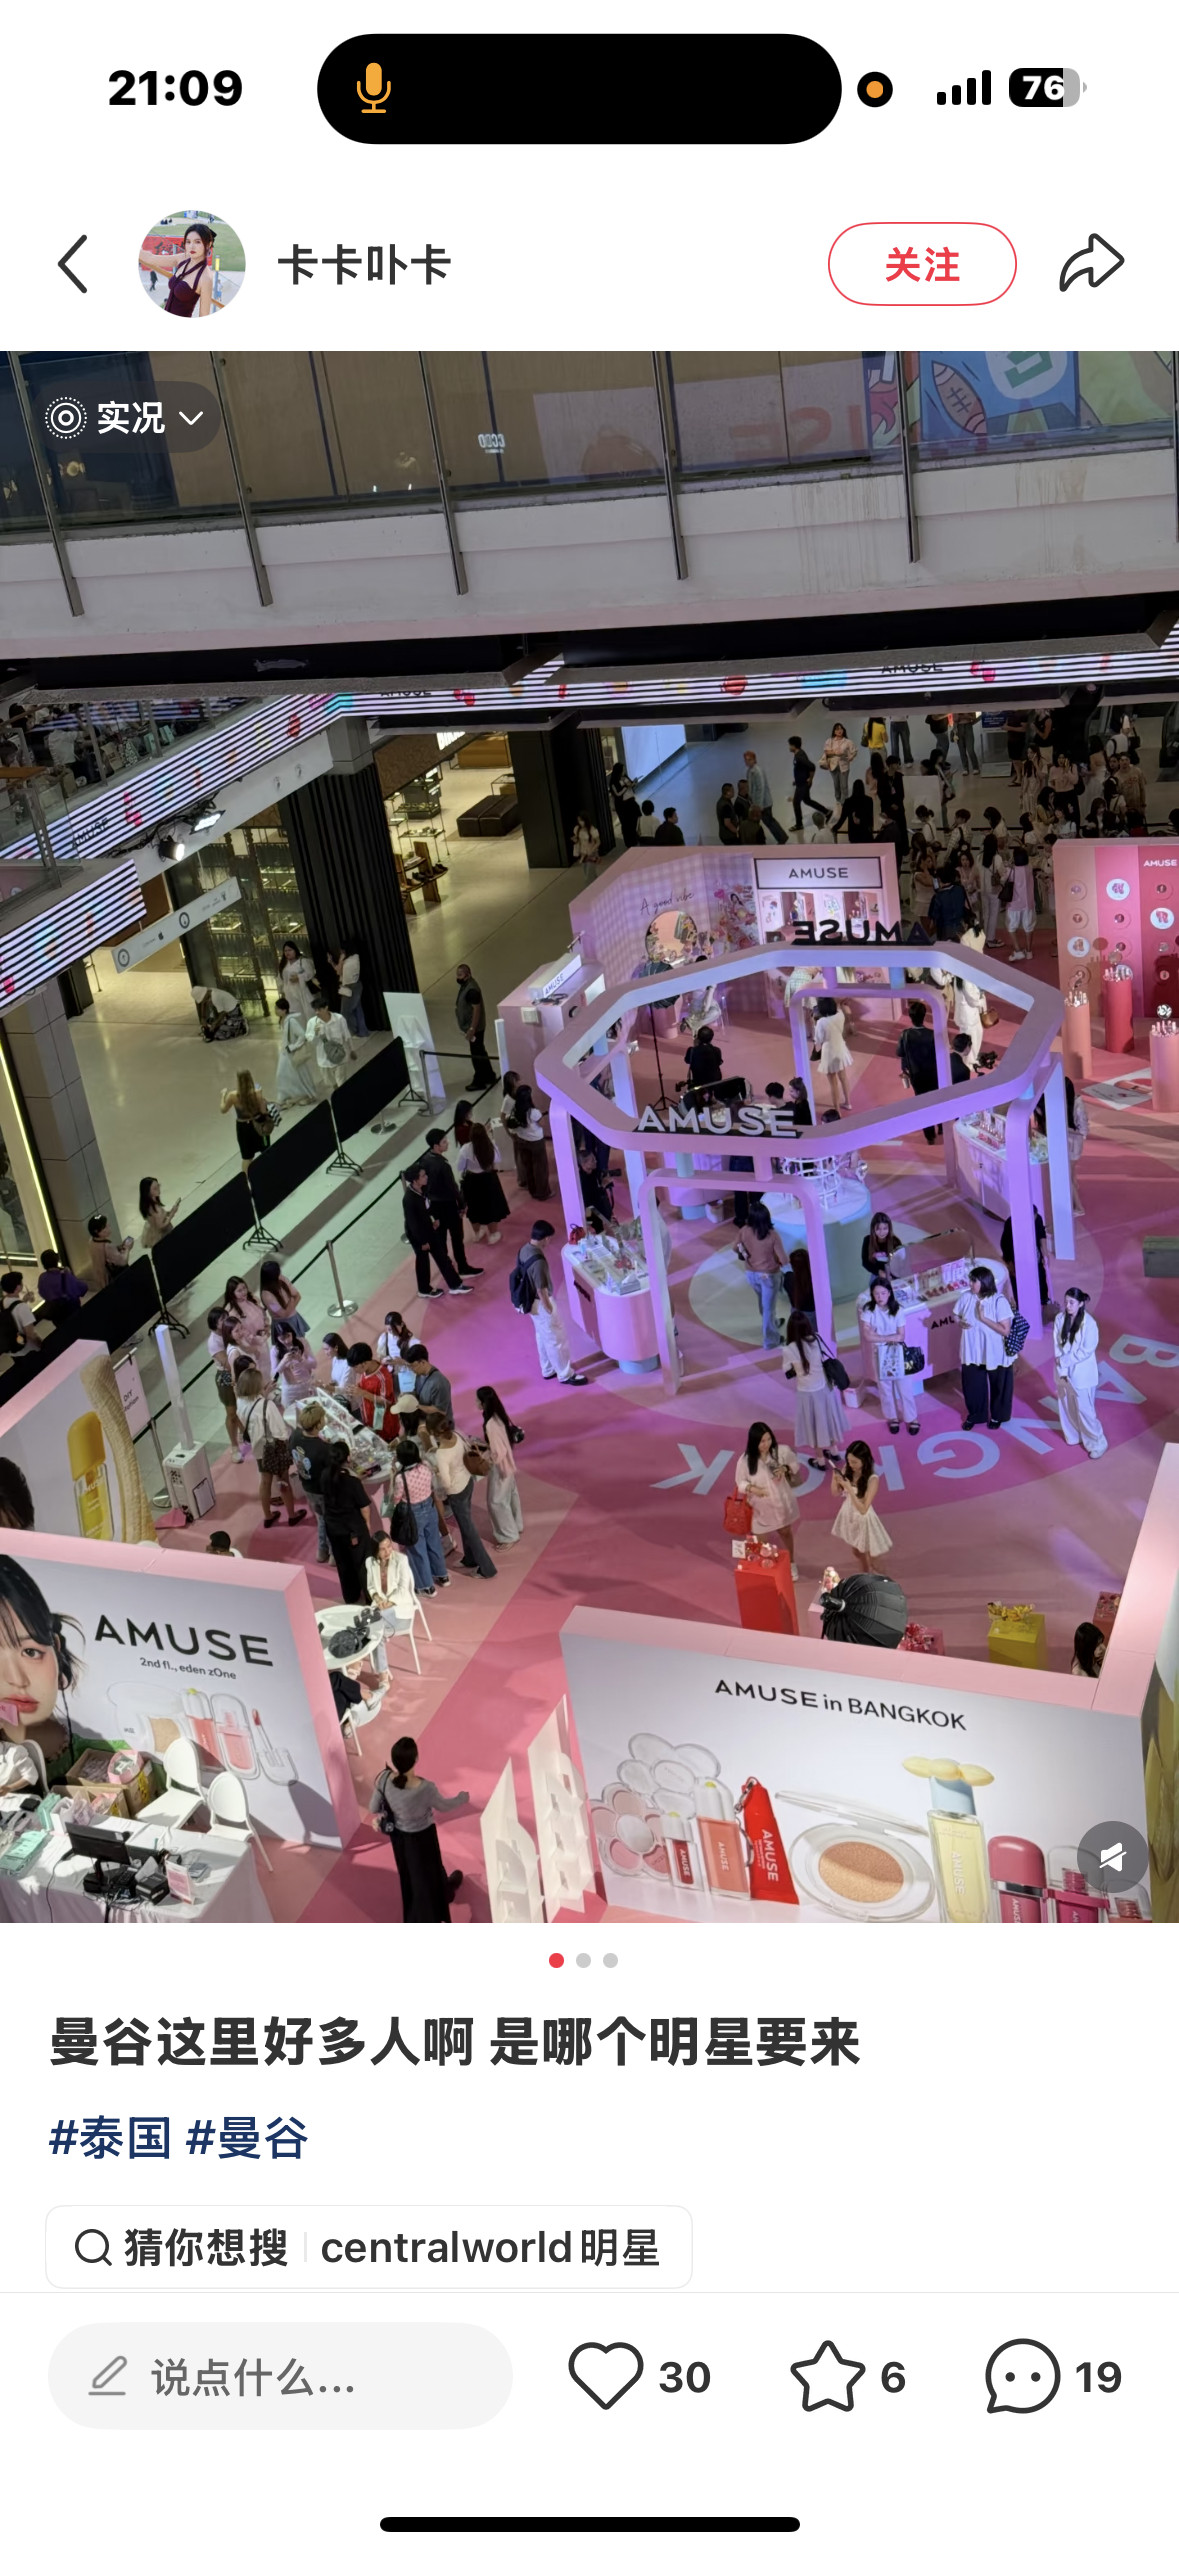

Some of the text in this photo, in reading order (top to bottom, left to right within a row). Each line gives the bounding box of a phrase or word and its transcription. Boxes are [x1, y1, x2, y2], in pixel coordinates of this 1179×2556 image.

[788, 867, 849, 879] AMUSE
[1143, 859, 1178, 867] AMUSE
[545, 973, 564, 995] AMUSE
[637, 1104, 798, 1138] AMUSE
[95, 1614, 274, 1667] AMUSE
[139, 1657, 161, 1669] 2nd
[179, 1664, 206, 1676] eden
[208, 1668, 237, 1680] zOne
[715, 1679, 967, 1731] AMUSE in BANGKOK
[680, 1848, 690, 1877] AMUSE
[718, 1841, 730, 1871] AMUSE
[762, 1829, 779, 1882] AMUSE
[951, 1852, 967, 1895] AMUSE
